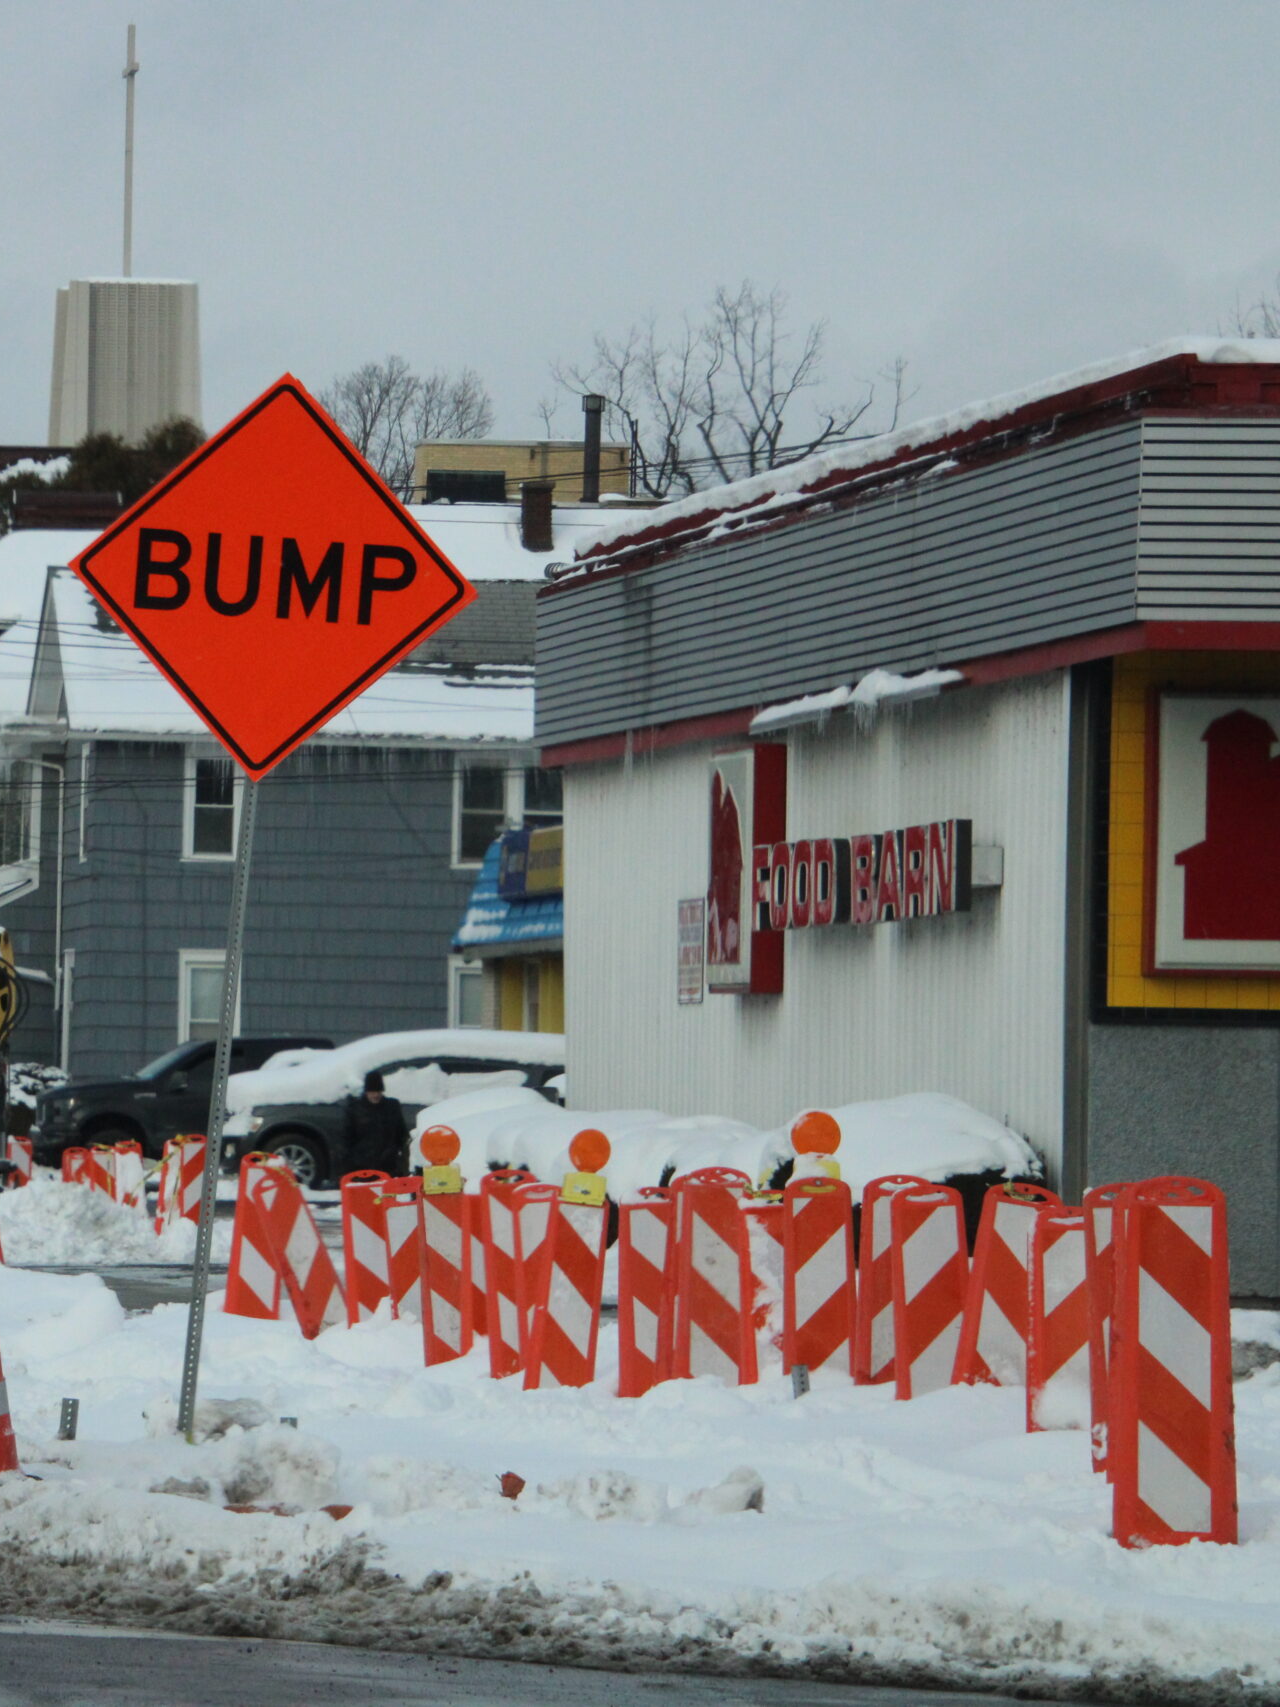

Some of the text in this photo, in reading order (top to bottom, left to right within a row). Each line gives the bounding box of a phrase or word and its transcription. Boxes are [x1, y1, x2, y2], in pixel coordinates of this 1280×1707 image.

[133, 528, 417, 625] BUMP
[752, 819, 958, 931] FOOD BARN
